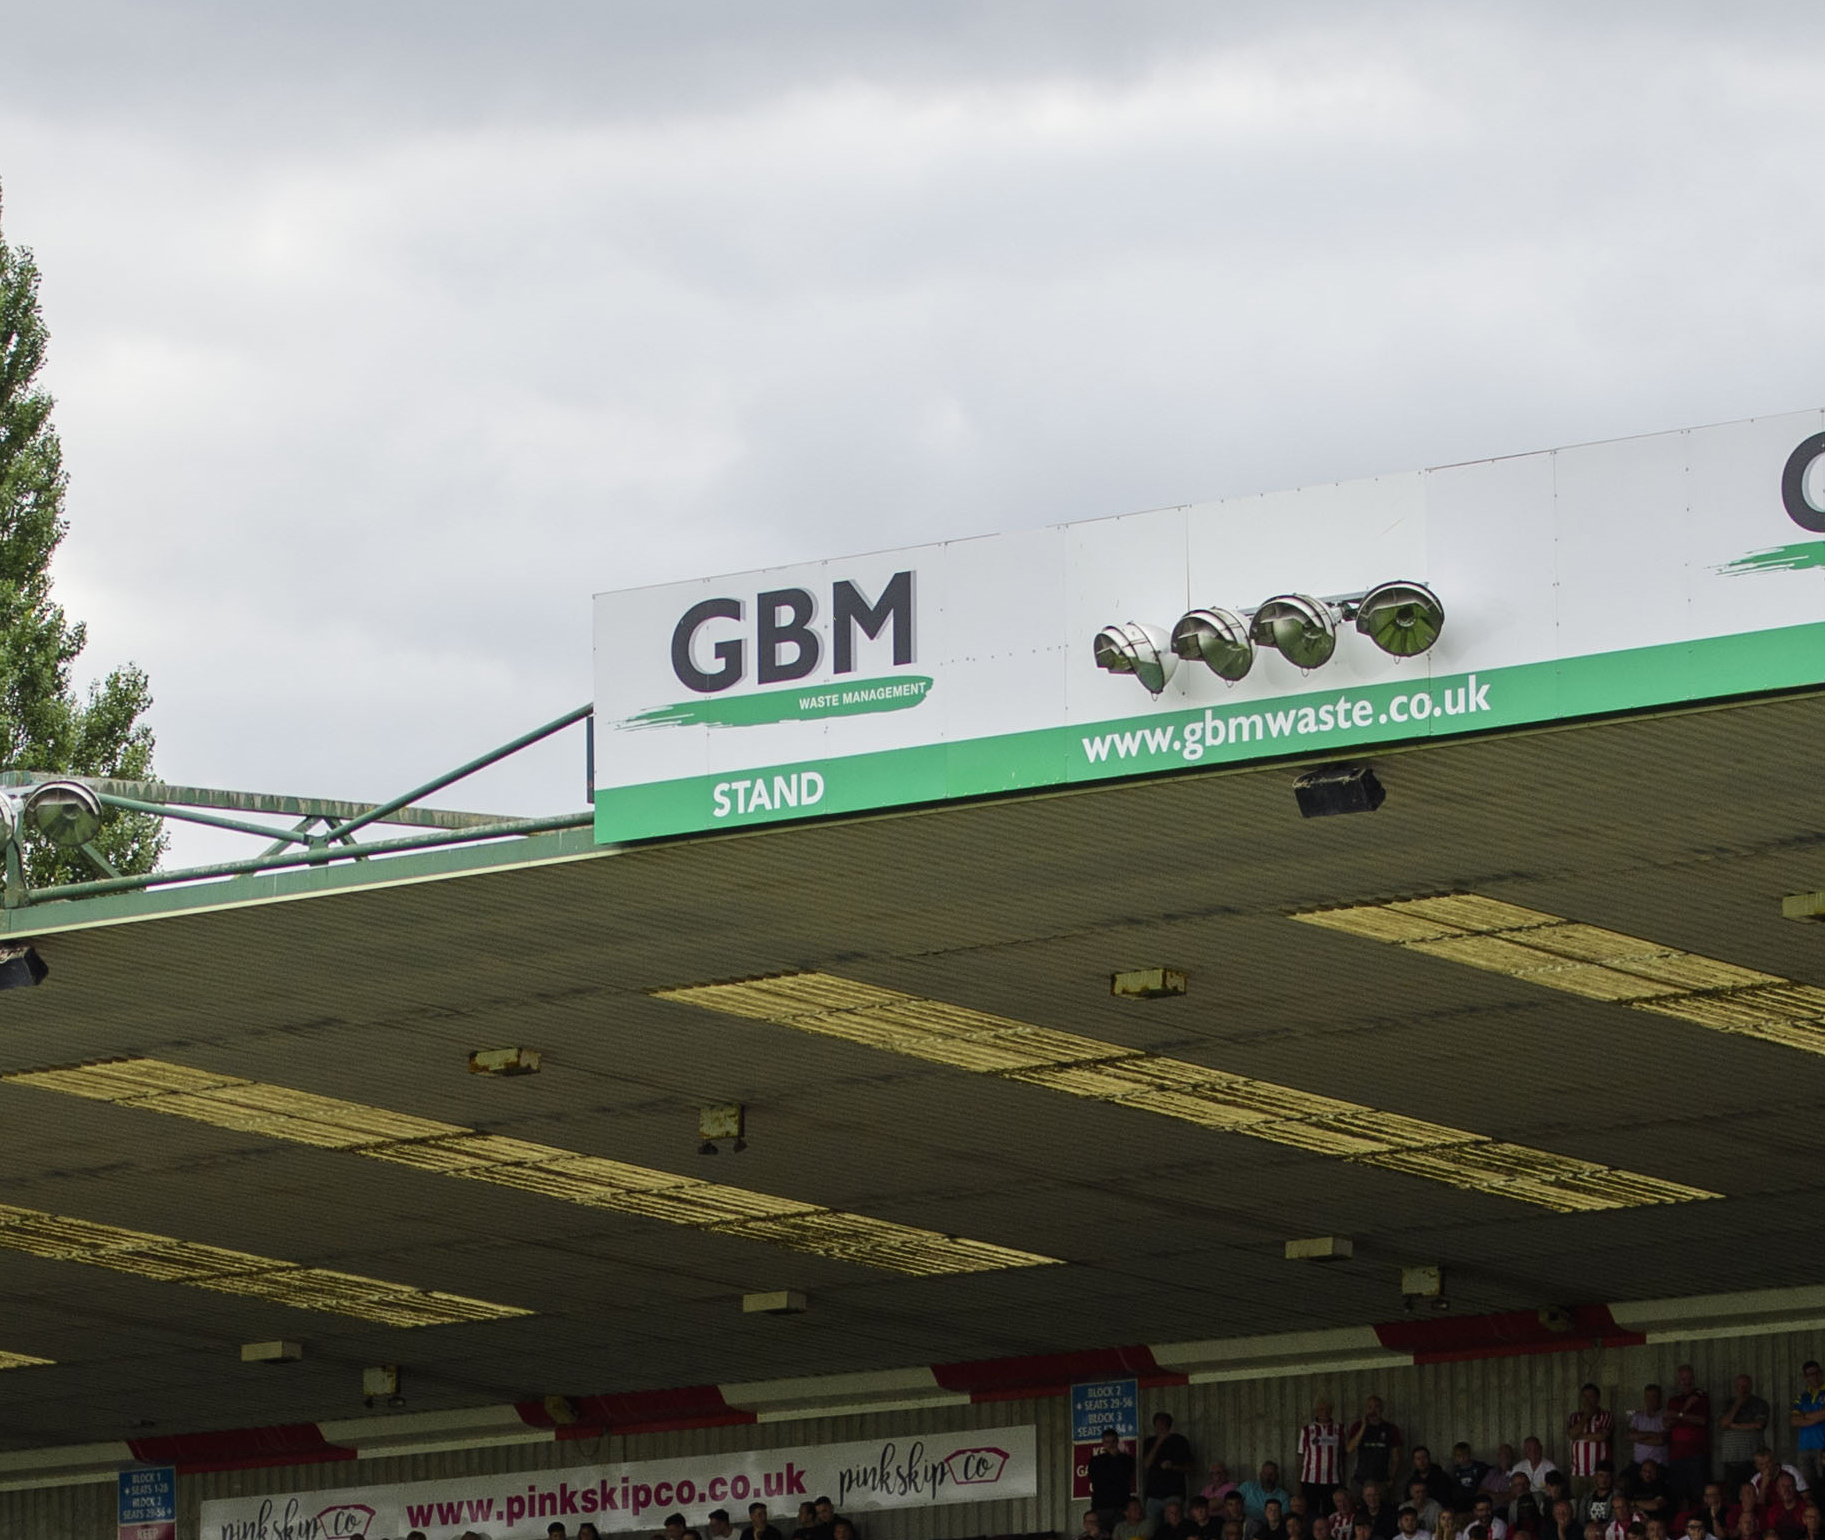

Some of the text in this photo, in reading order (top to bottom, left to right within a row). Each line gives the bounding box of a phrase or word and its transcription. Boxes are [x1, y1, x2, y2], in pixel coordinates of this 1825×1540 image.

[671, 570, 917, 693] GBM
[798, 682, 926, 711] WASTE MANAGEMENT
[1082, 674, 1492, 762] www.gbmwaste.co.uk
[713, 771, 824, 818] STAND
[1085, 1398, 1108, 1410] SEATS
[1087, 1387, 1114, 1398] BLOCK
[1078, 1426, 1102, 1437] SEATS
[1088, 1412, 1114, 1424] BLOCK
[406, 1462, 808, 1528] www.pinkskipco.co.uk
